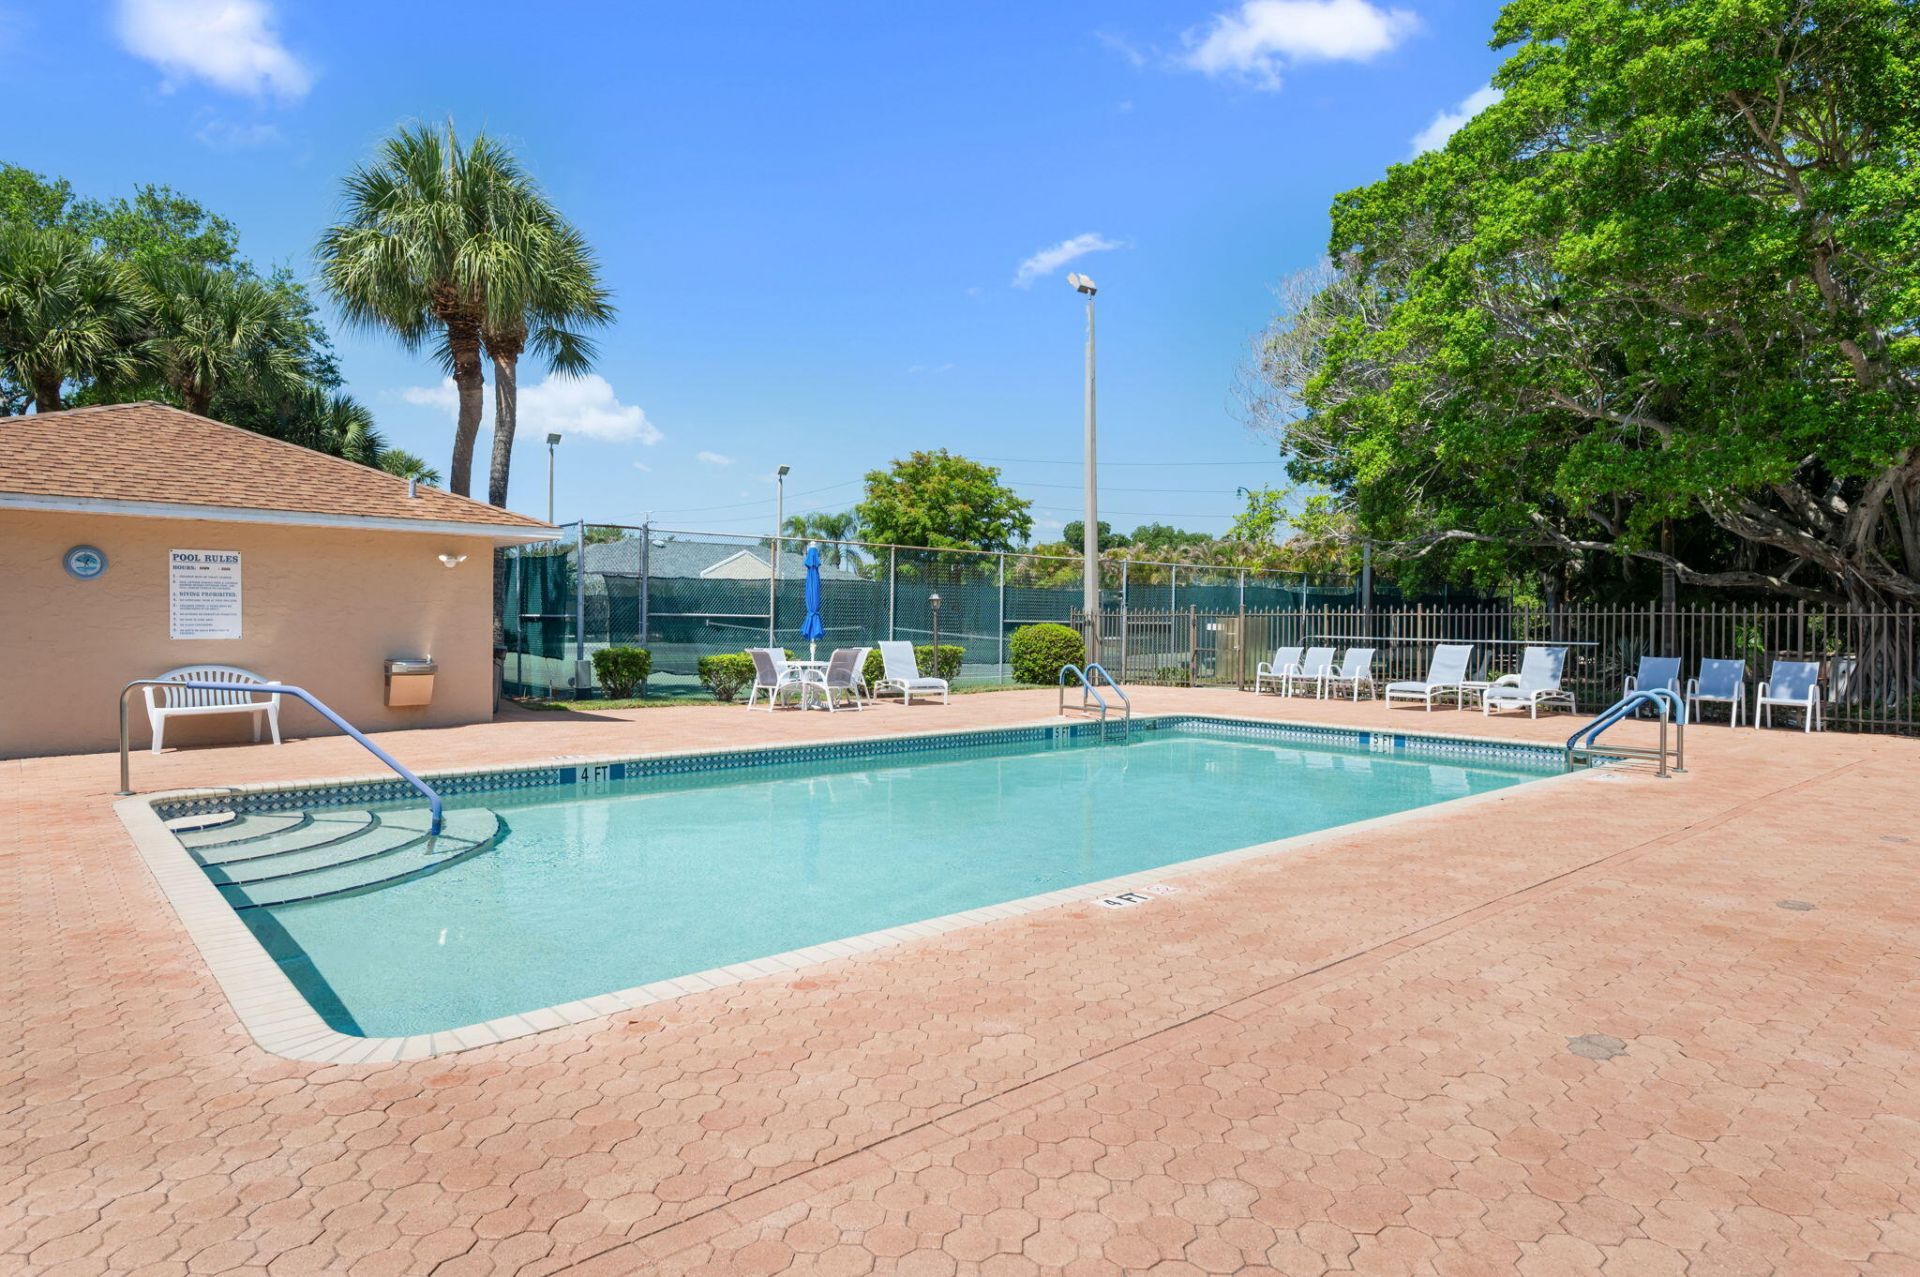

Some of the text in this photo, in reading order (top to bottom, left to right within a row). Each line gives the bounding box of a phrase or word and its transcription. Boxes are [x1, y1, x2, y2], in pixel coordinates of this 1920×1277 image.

[172, 553, 239, 563] POOL RULES
[1373, 733, 1392, 745] 5 FT
[581, 766, 608, 782] 4 FT
[1116, 892, 1149, 903] FT
